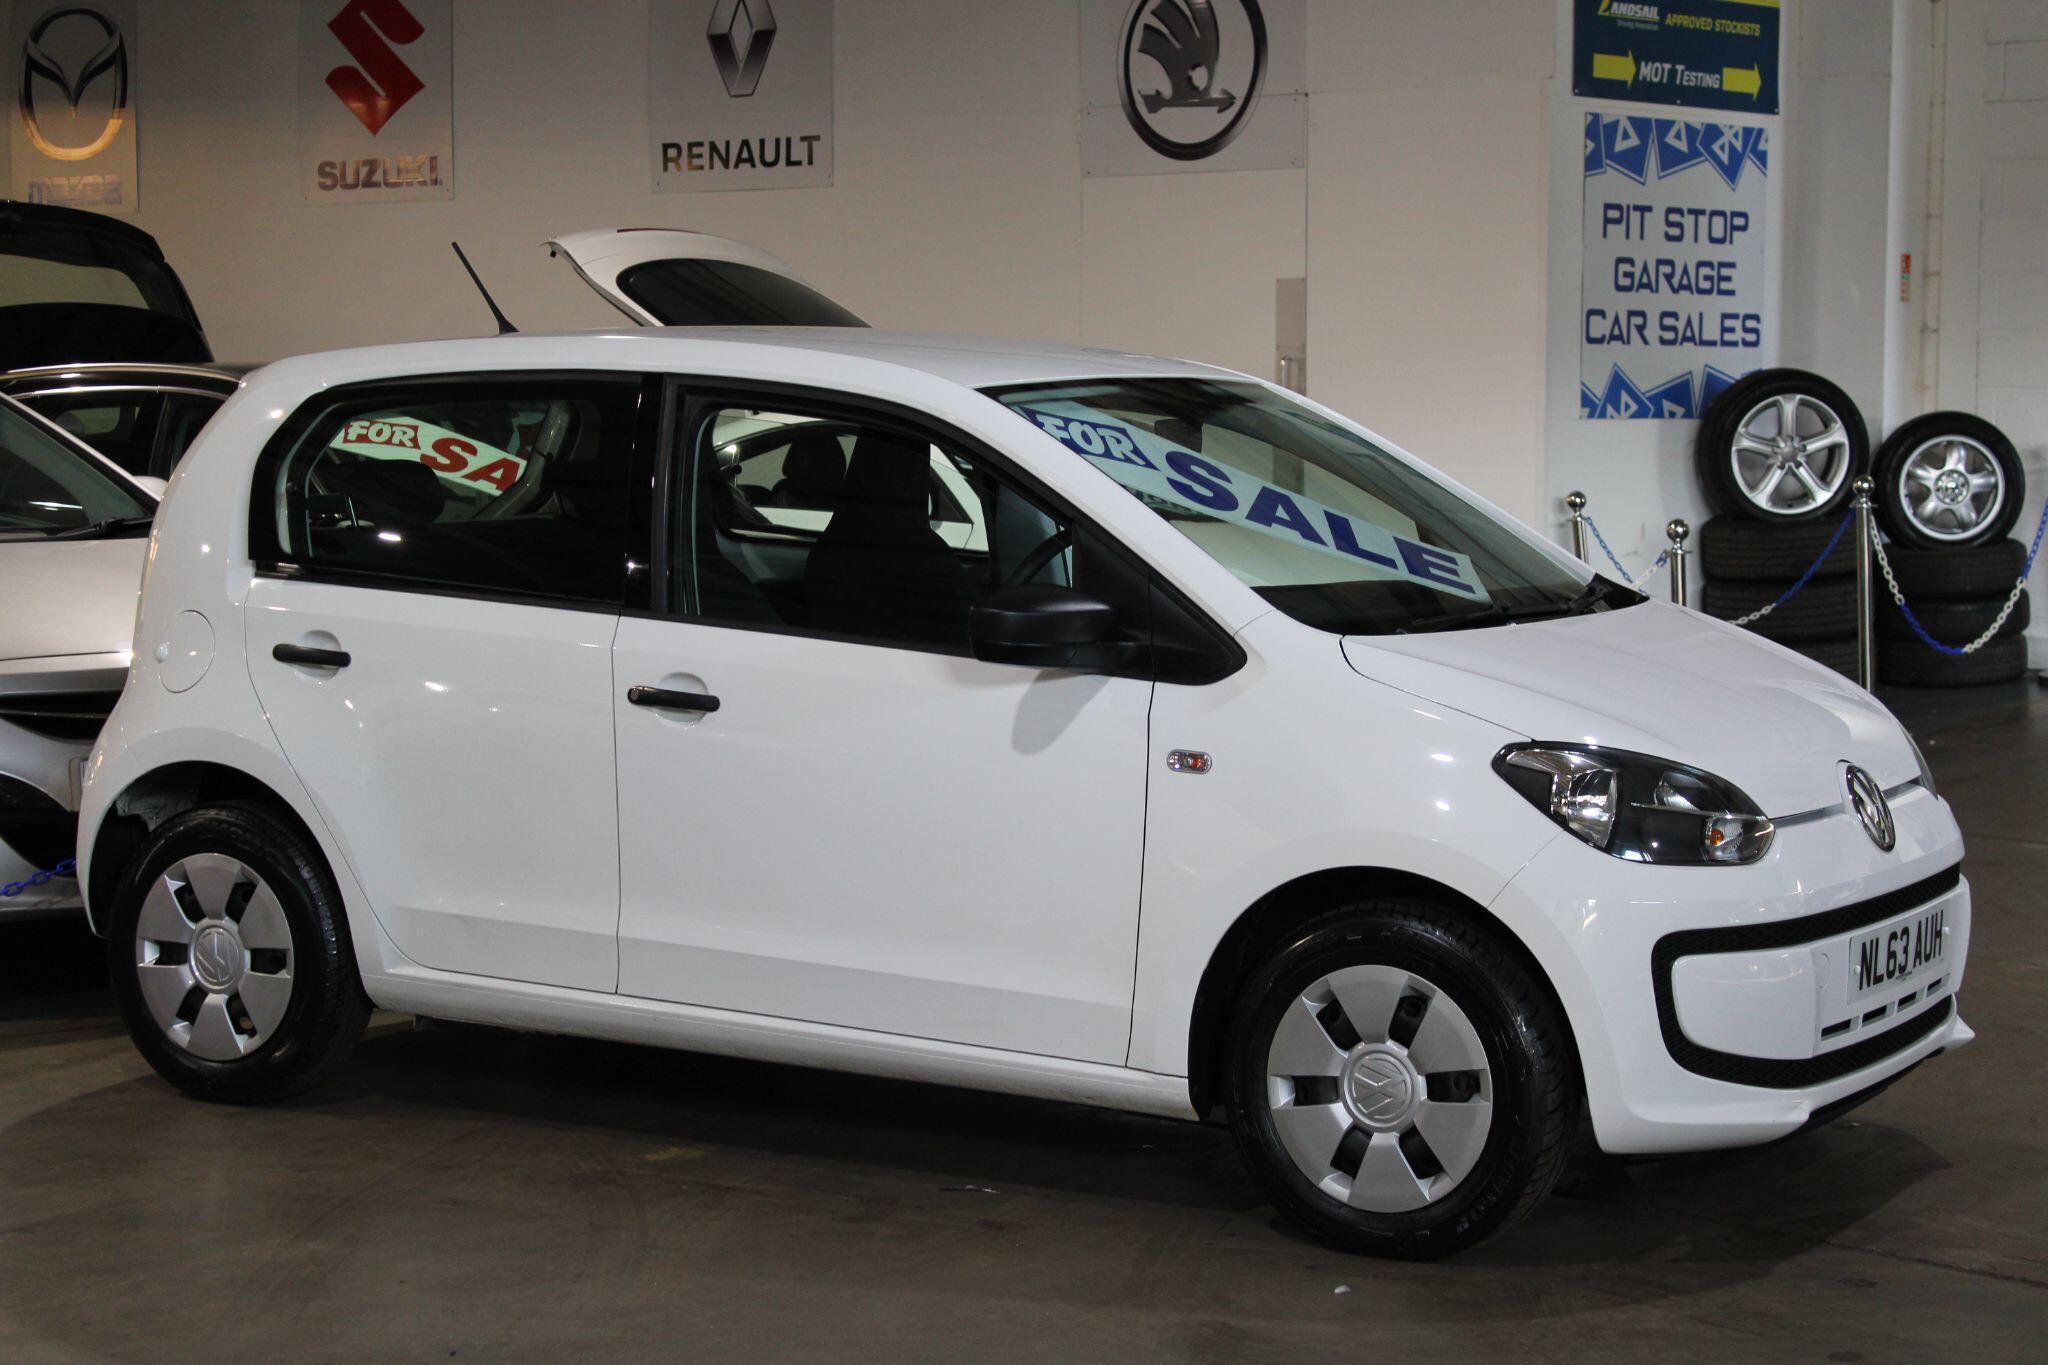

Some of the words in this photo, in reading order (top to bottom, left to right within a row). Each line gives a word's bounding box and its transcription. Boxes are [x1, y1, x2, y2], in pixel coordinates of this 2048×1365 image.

[1665, 13, 1713, 31] APPROVED
[1714, 18, 1761, 37] STOCKISTS
[1638, 60, 1674, 85] MOT
[661, 134, 821, 173] RENAULT
[1602, 202, 1653, 241] PIT
[1664, 206, 1750, 245] STOP
[1613, 256, 1737, 297] GARAGE
[1585, 308, 1650, 346] CAR
[1658, 310, 1762, 348] SALES
[346, 420, 415, 448] FOR
[1032, 412, 1146, 467] FOR
[1164, 450, 1476, 595] SALE
[1858, 926, 1910, 991] NL63
[1912, 909, 1944, 969] AUH
